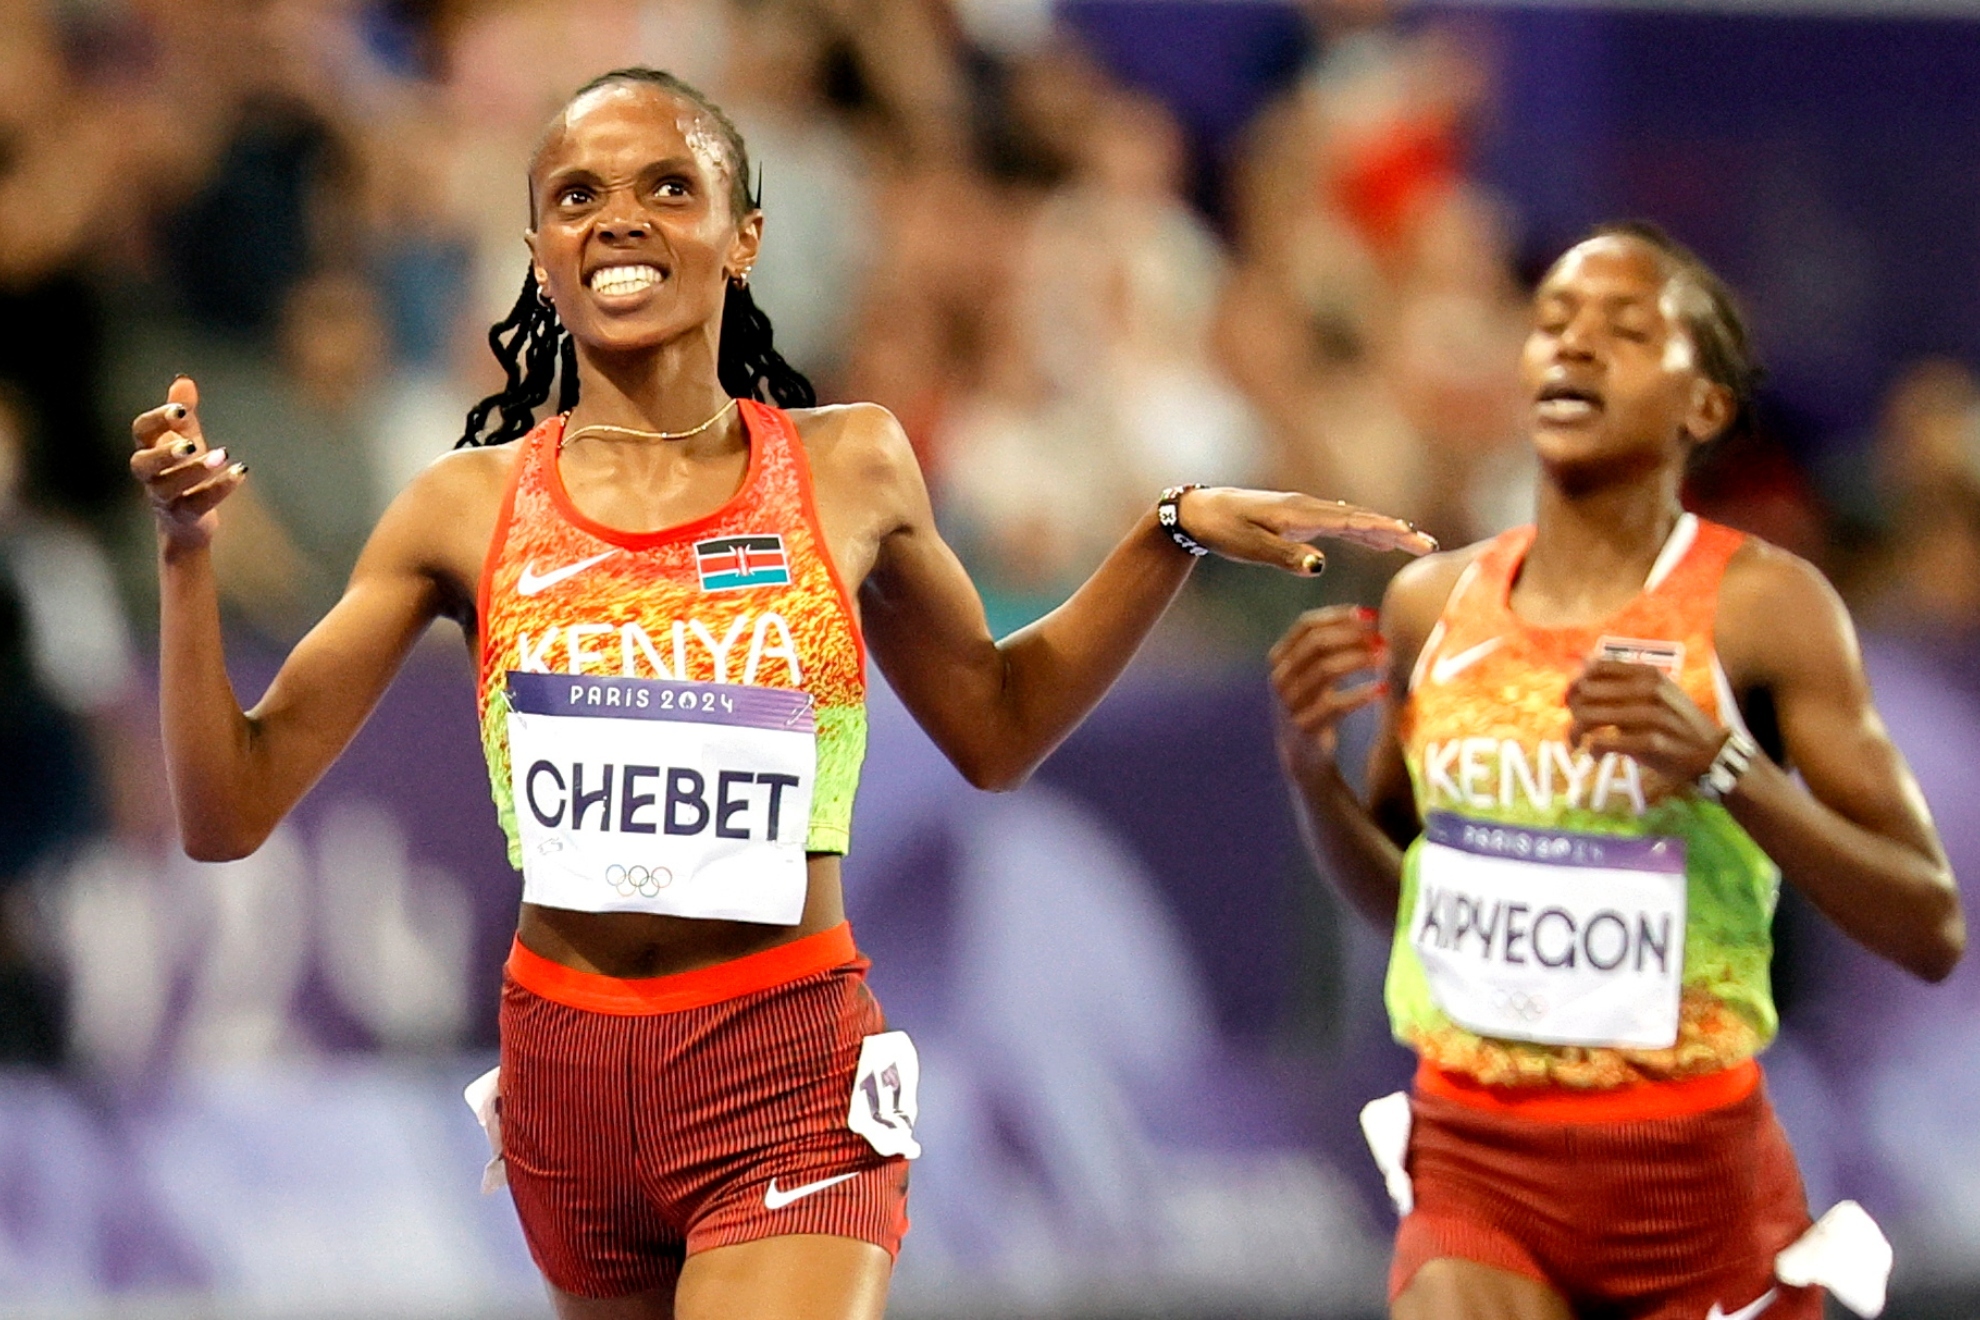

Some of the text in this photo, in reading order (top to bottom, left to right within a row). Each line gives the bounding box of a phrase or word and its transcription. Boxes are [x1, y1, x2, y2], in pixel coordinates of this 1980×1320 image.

[518, 612, 804, 686] KENYA
[570, 685, 734, 713] PARIS 2024
[525, 759, 800, 842] CHEBET
[1424, 738, 1646, 815] KENYA
[1417, 885, 1672, 973] KIPYEGON
